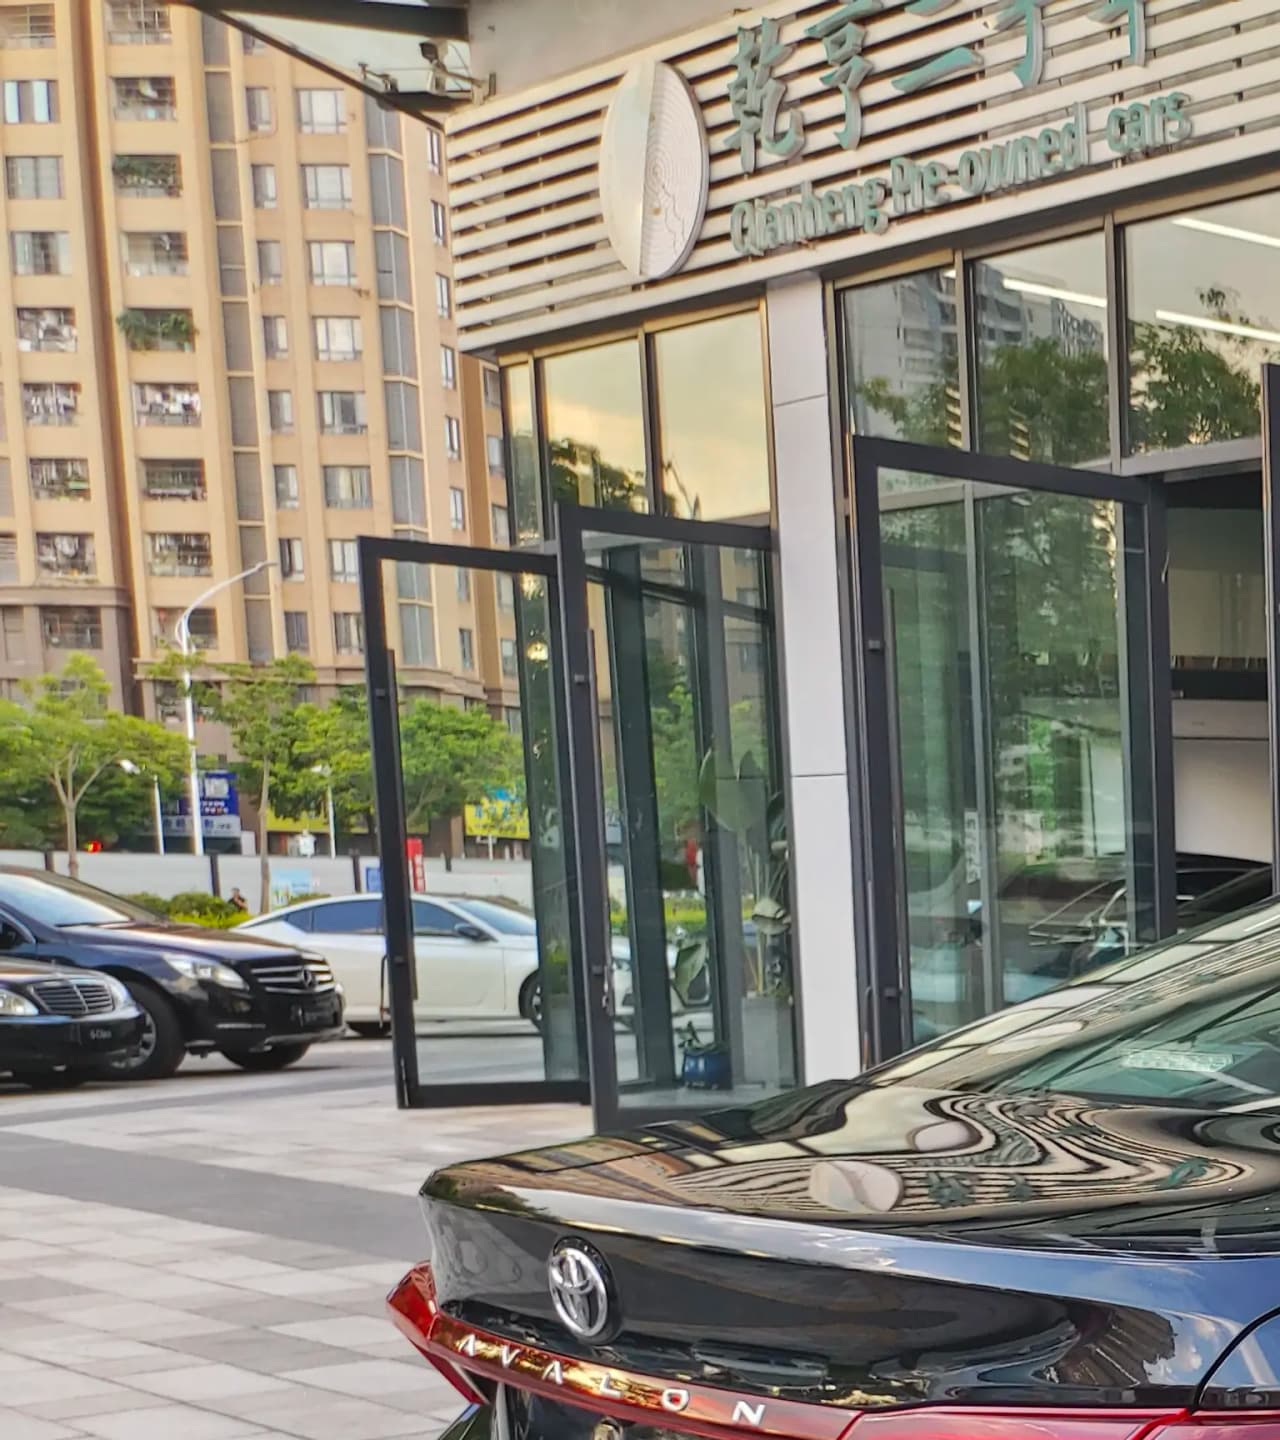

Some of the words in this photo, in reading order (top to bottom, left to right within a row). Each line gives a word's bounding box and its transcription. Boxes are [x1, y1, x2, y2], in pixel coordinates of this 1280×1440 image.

[730, 177, 889, 257] Qianheng
[891, 101, 1088, 215] Pre-owned
[1106, 91, 1193, 154] cars
[457, 1333, 766, 1426] AVALON
